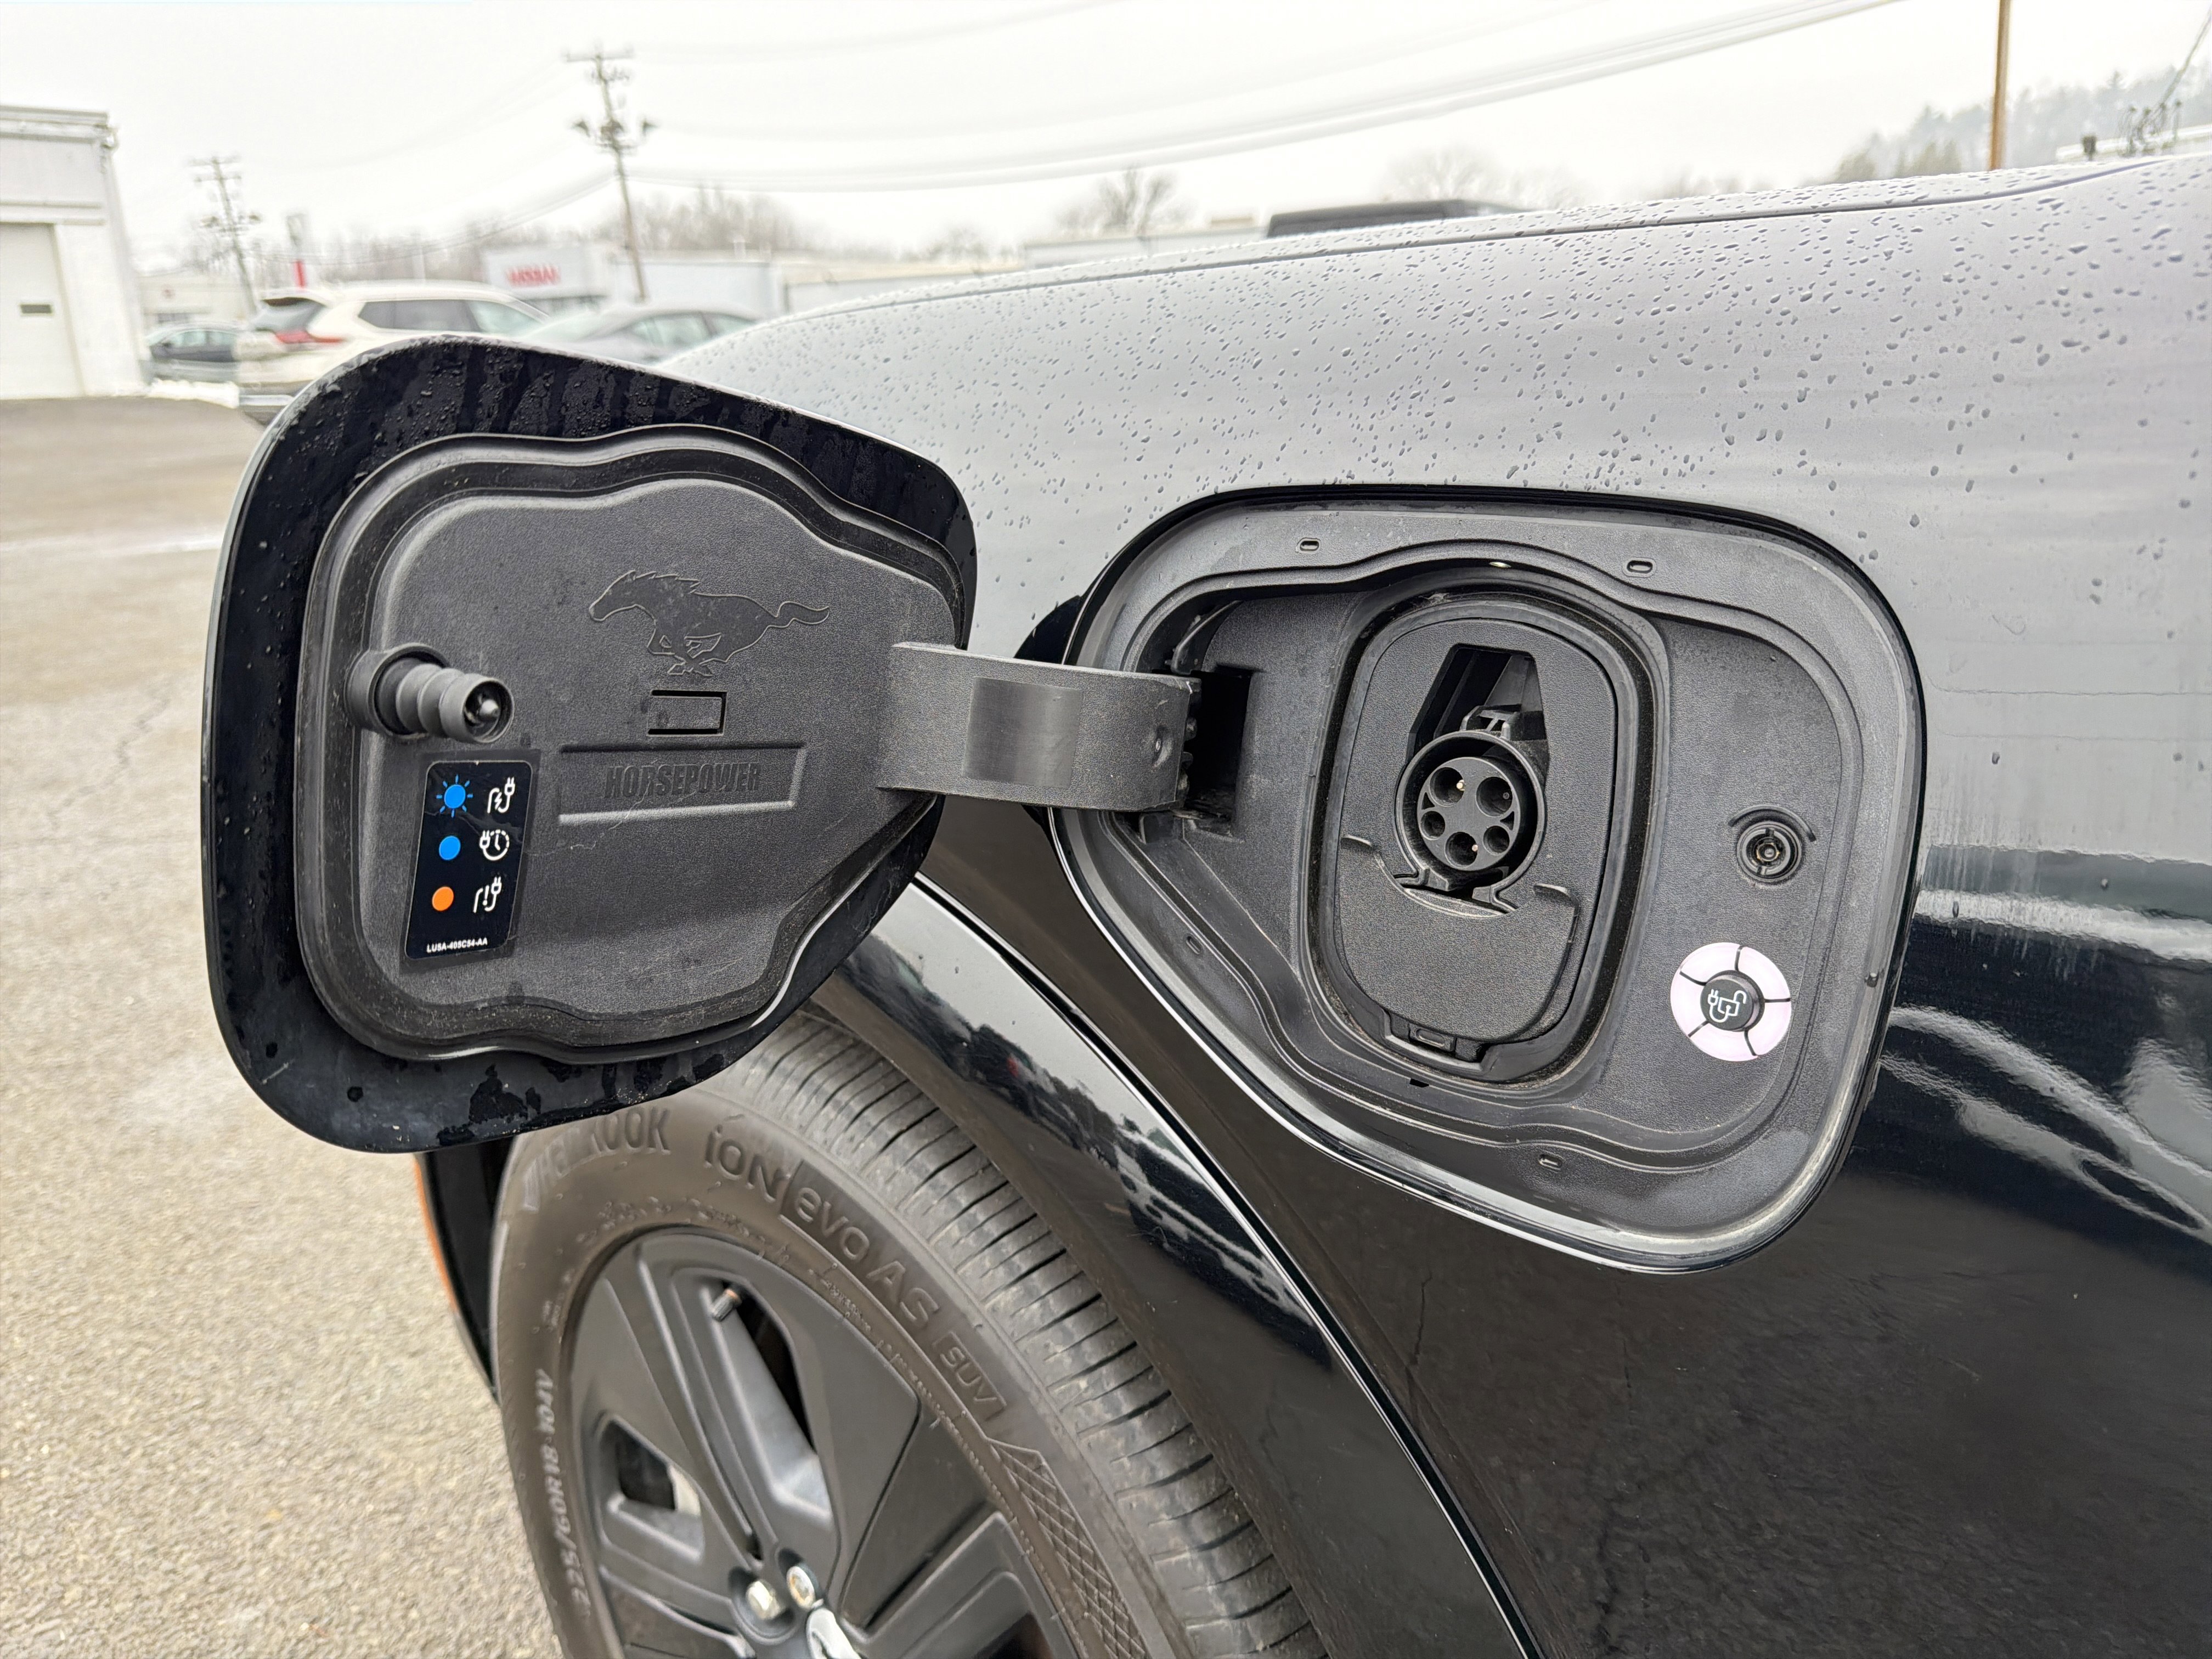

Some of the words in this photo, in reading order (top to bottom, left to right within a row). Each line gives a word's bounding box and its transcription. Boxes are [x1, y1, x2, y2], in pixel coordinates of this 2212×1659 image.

[604, 762, 760, 798] HORSEPOWER
[794, 1187, 870, 1261] evo
[866, 1261, 940, 1328] AS
[940, 1346, 998, 1406] SUV
